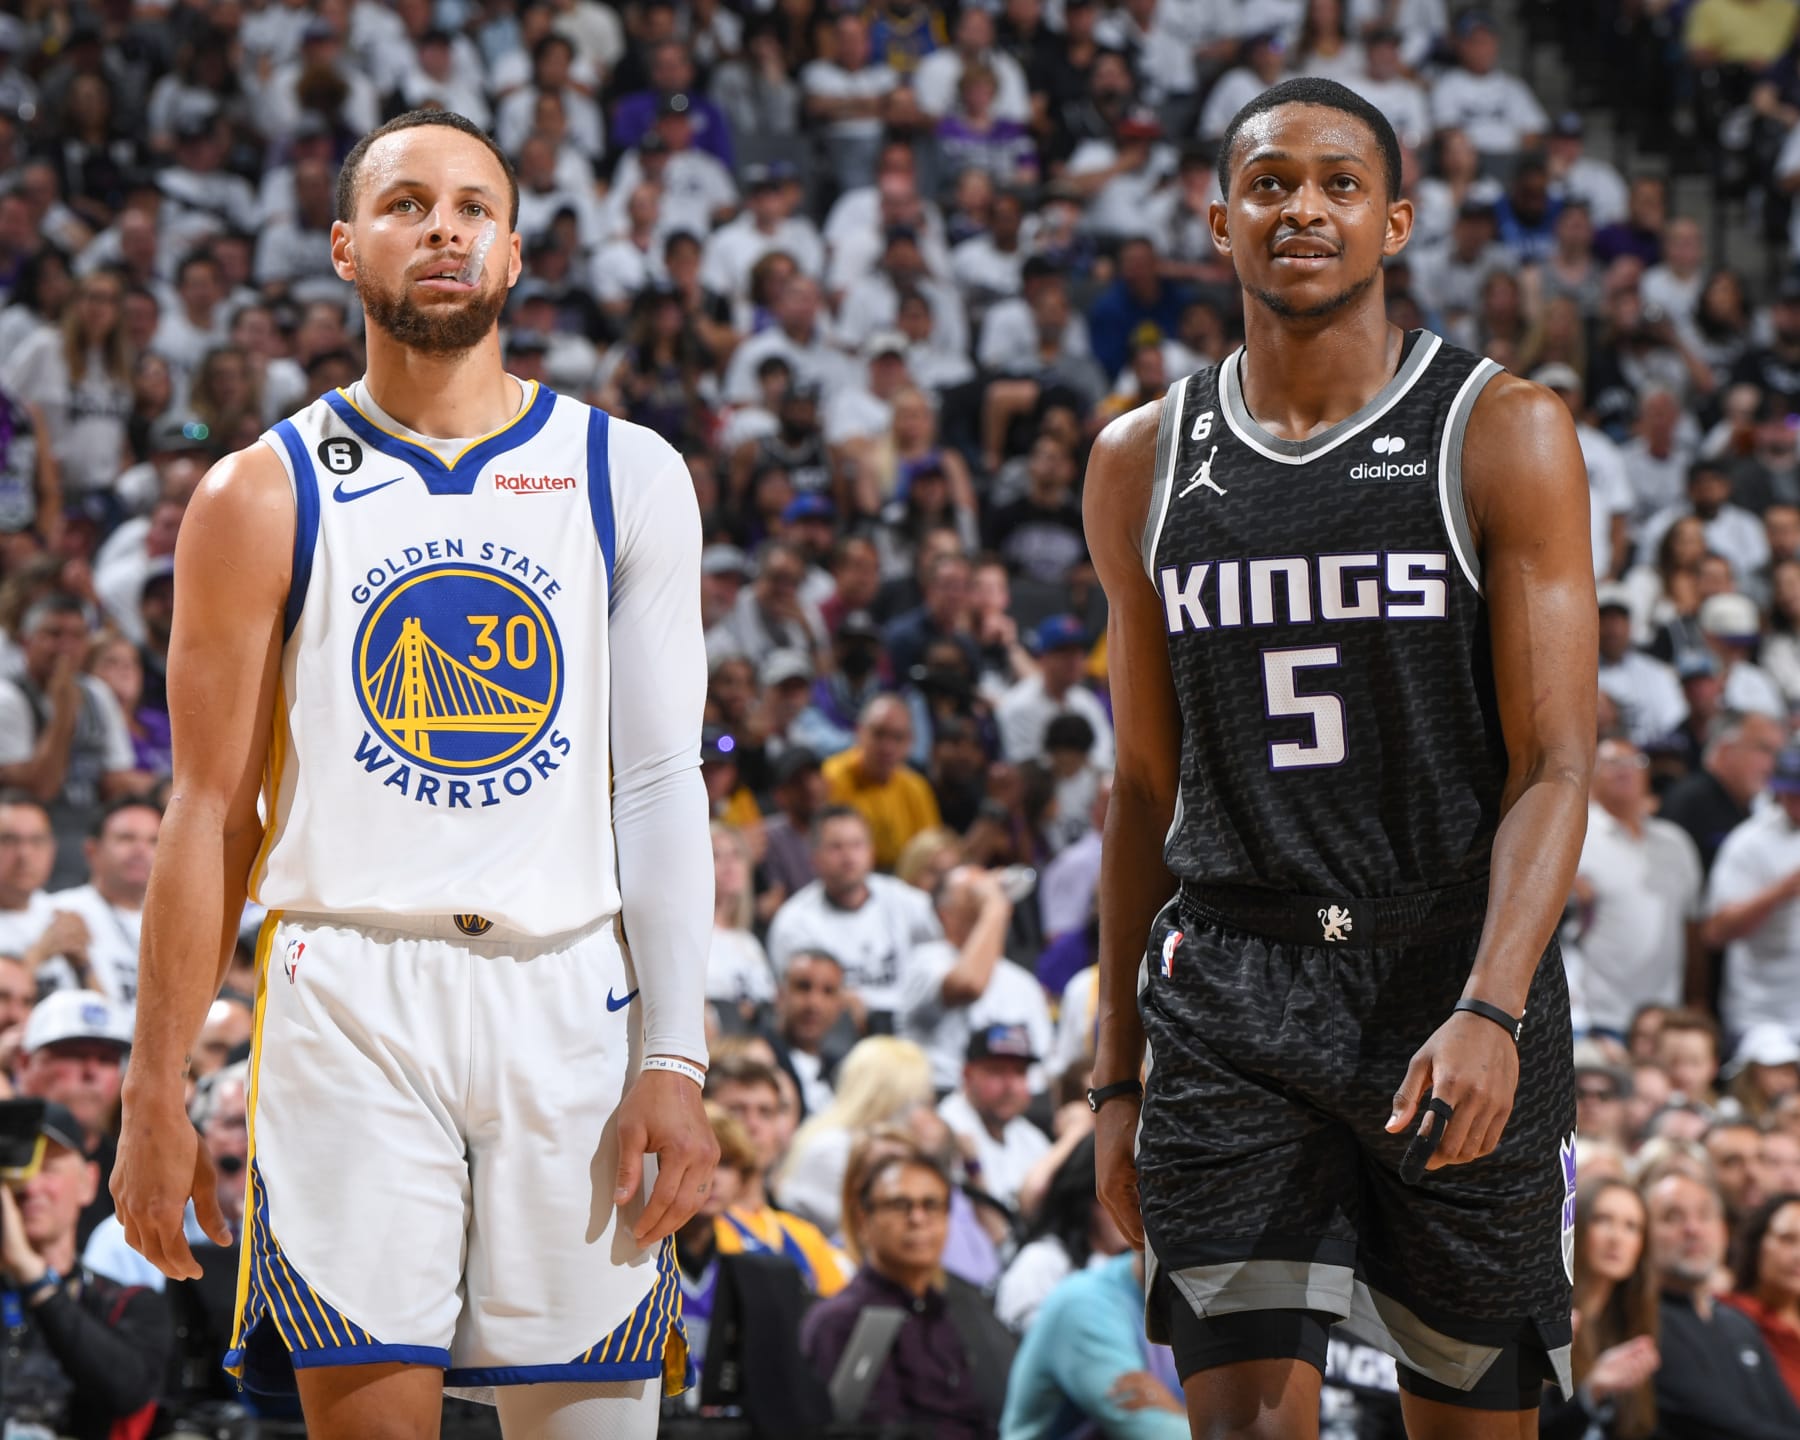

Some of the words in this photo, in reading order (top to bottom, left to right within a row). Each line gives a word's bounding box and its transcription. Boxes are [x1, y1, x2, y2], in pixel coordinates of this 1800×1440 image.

[1191, 411, 1214, 440] 6
[327, 442, 352, 470] 6
[495, 474, 576, 490] Rakuten
[1350, 459, 1427, 481] dialpad
[351, 538, 464, 604] GOLDEN
[480, 542, 562, 600] STATE
[1159, 551, 1449, 636] KINGS
[466, 615, 537, 671] 30
[1260, 643, 1349, 771] 5
[353, 730, 571, 808] WARRIORS
